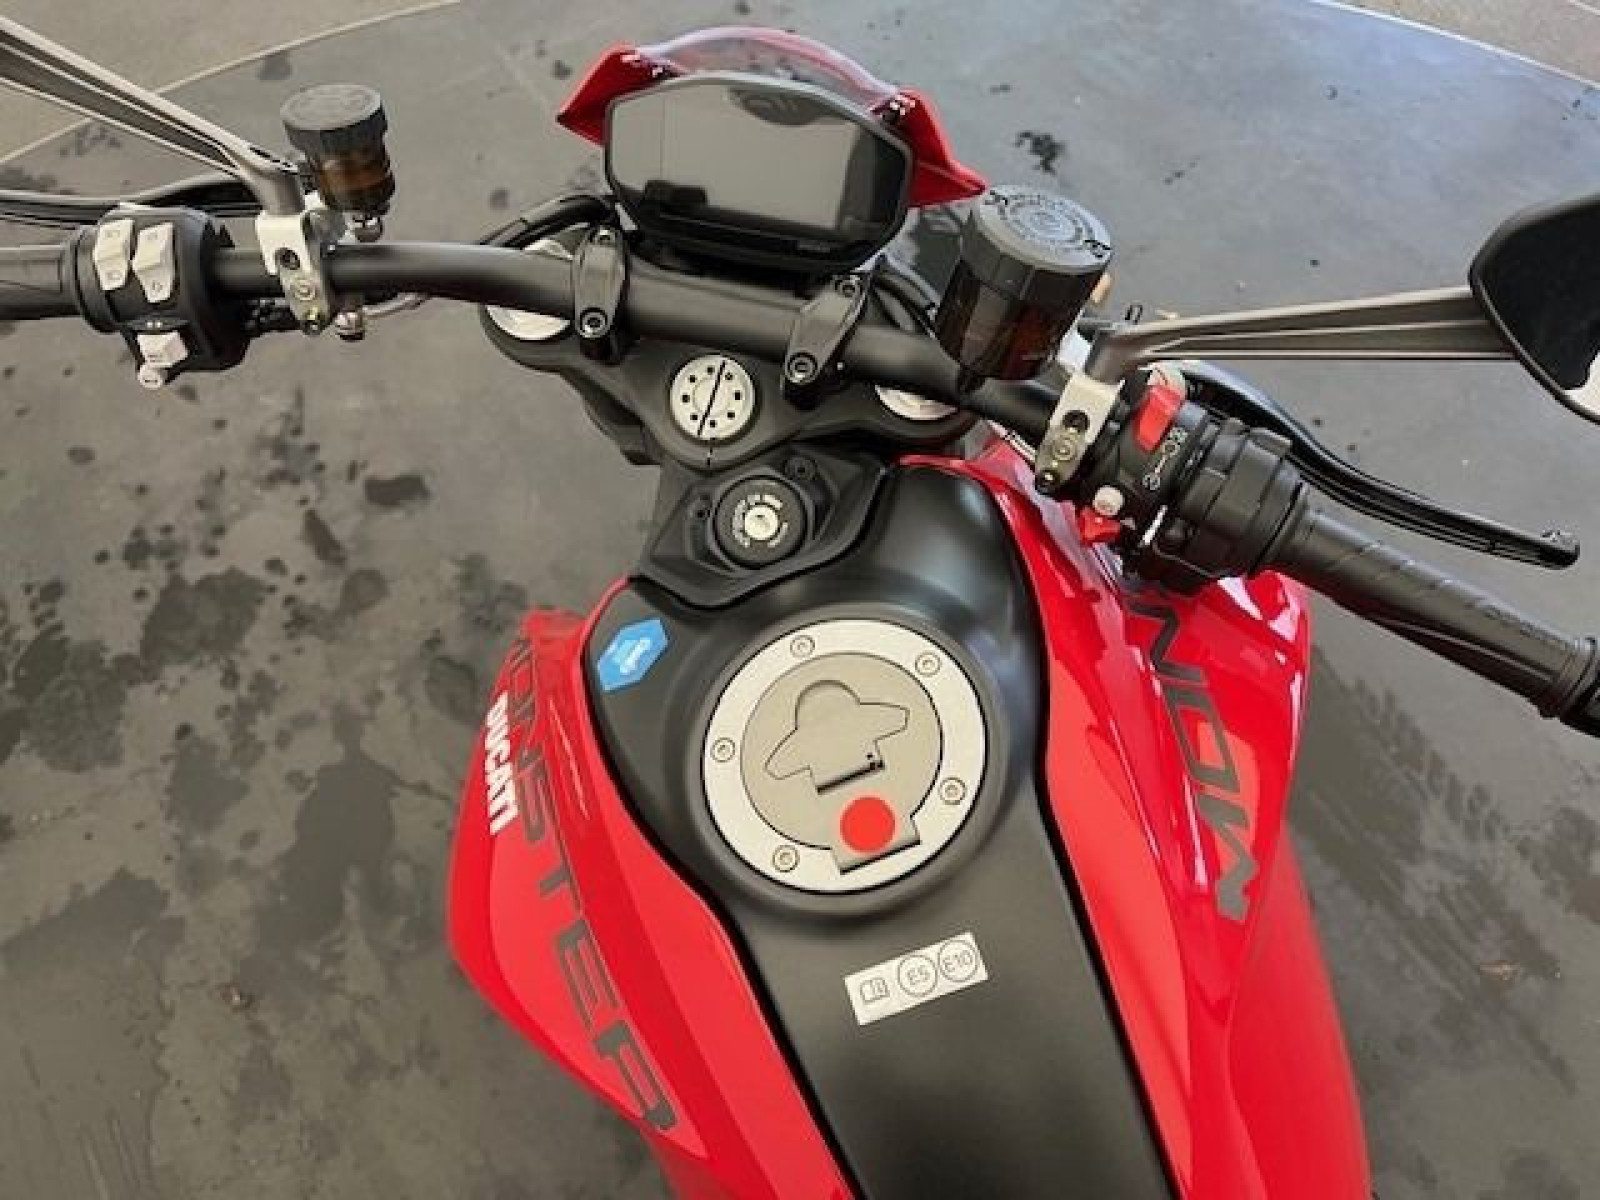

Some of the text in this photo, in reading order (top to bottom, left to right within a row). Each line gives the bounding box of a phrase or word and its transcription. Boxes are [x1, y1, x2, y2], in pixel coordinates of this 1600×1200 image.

[484, 691, 519, 835] DUCATI
[907, 950, 974, 986] E5 E10
